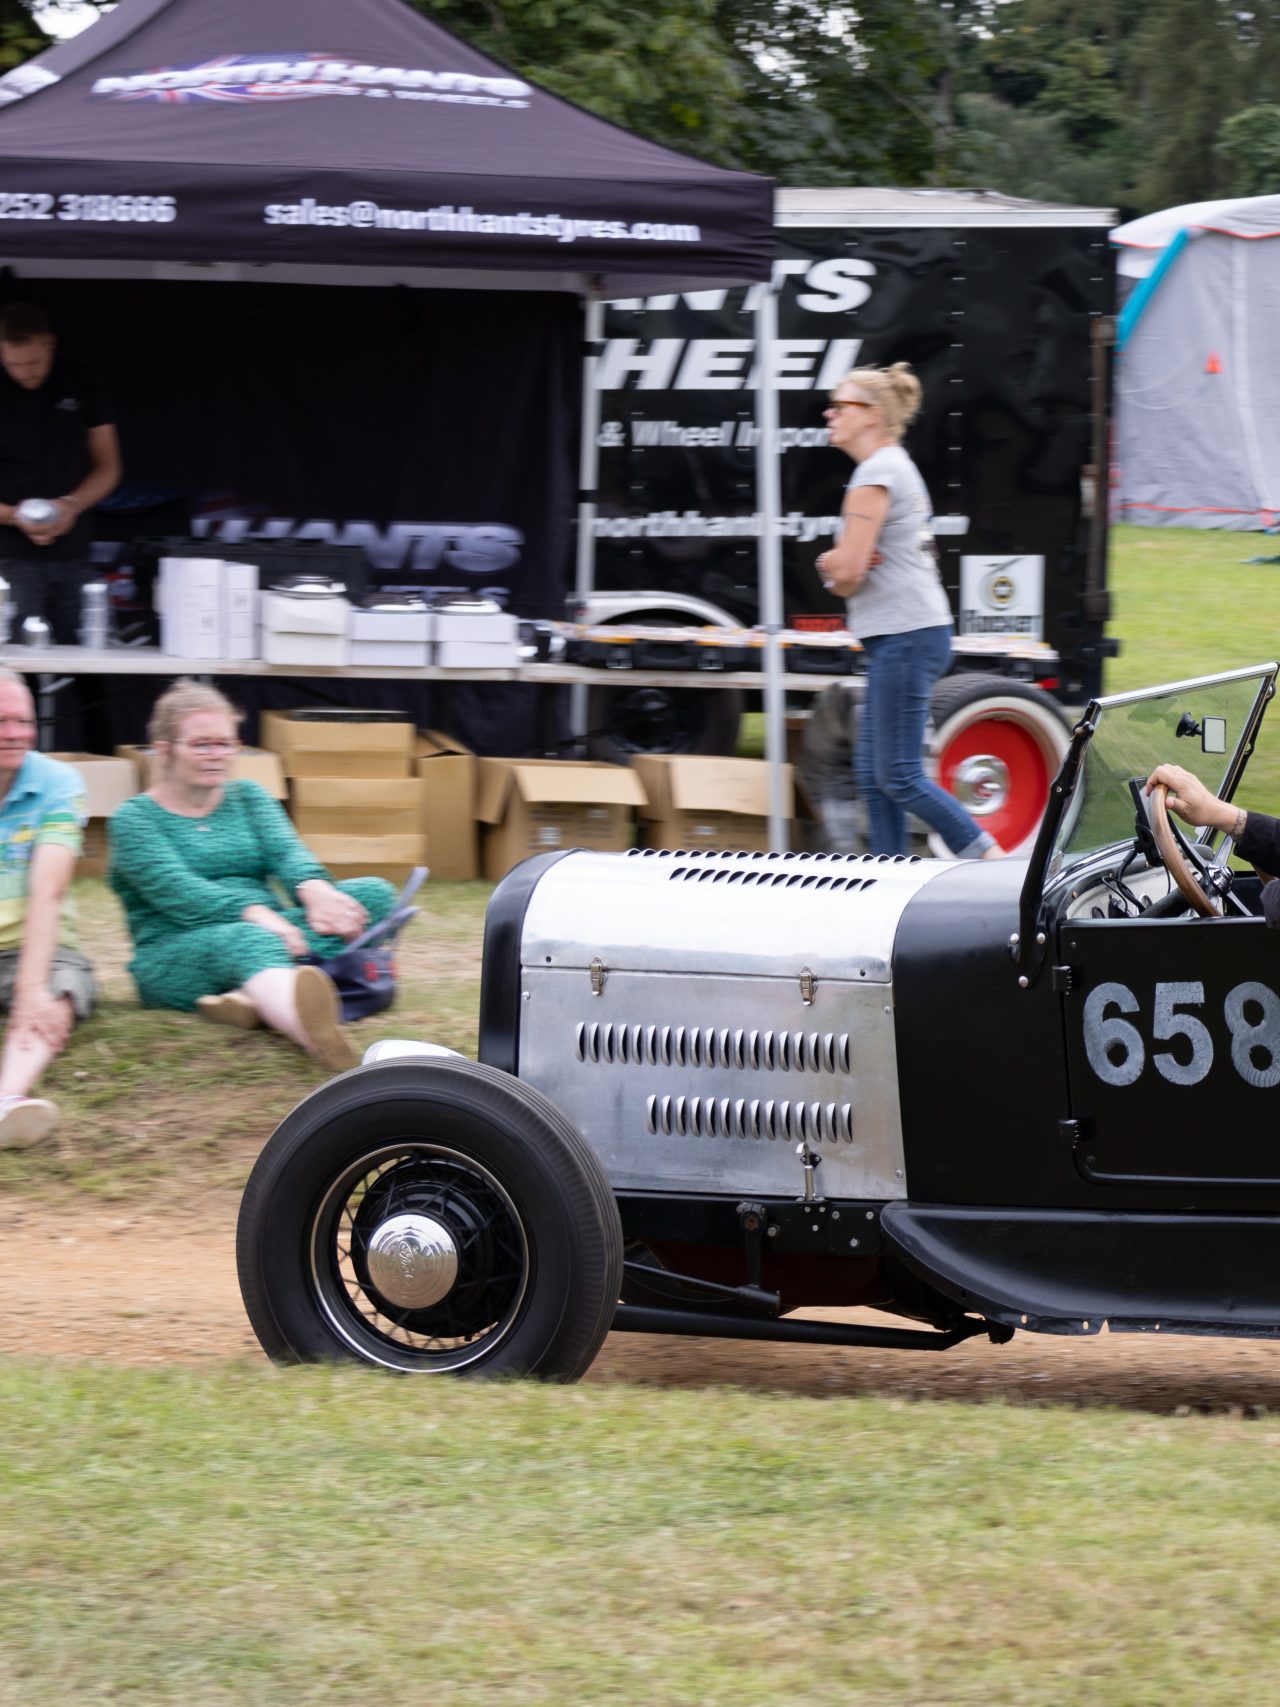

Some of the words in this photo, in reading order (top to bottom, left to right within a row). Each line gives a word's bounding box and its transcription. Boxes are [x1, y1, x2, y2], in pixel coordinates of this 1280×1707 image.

[263, 197, 701, 243] sales@northhantstyres.com
[596, 421, 626, 447] &
[631, 420, 737, 447] Wheel
